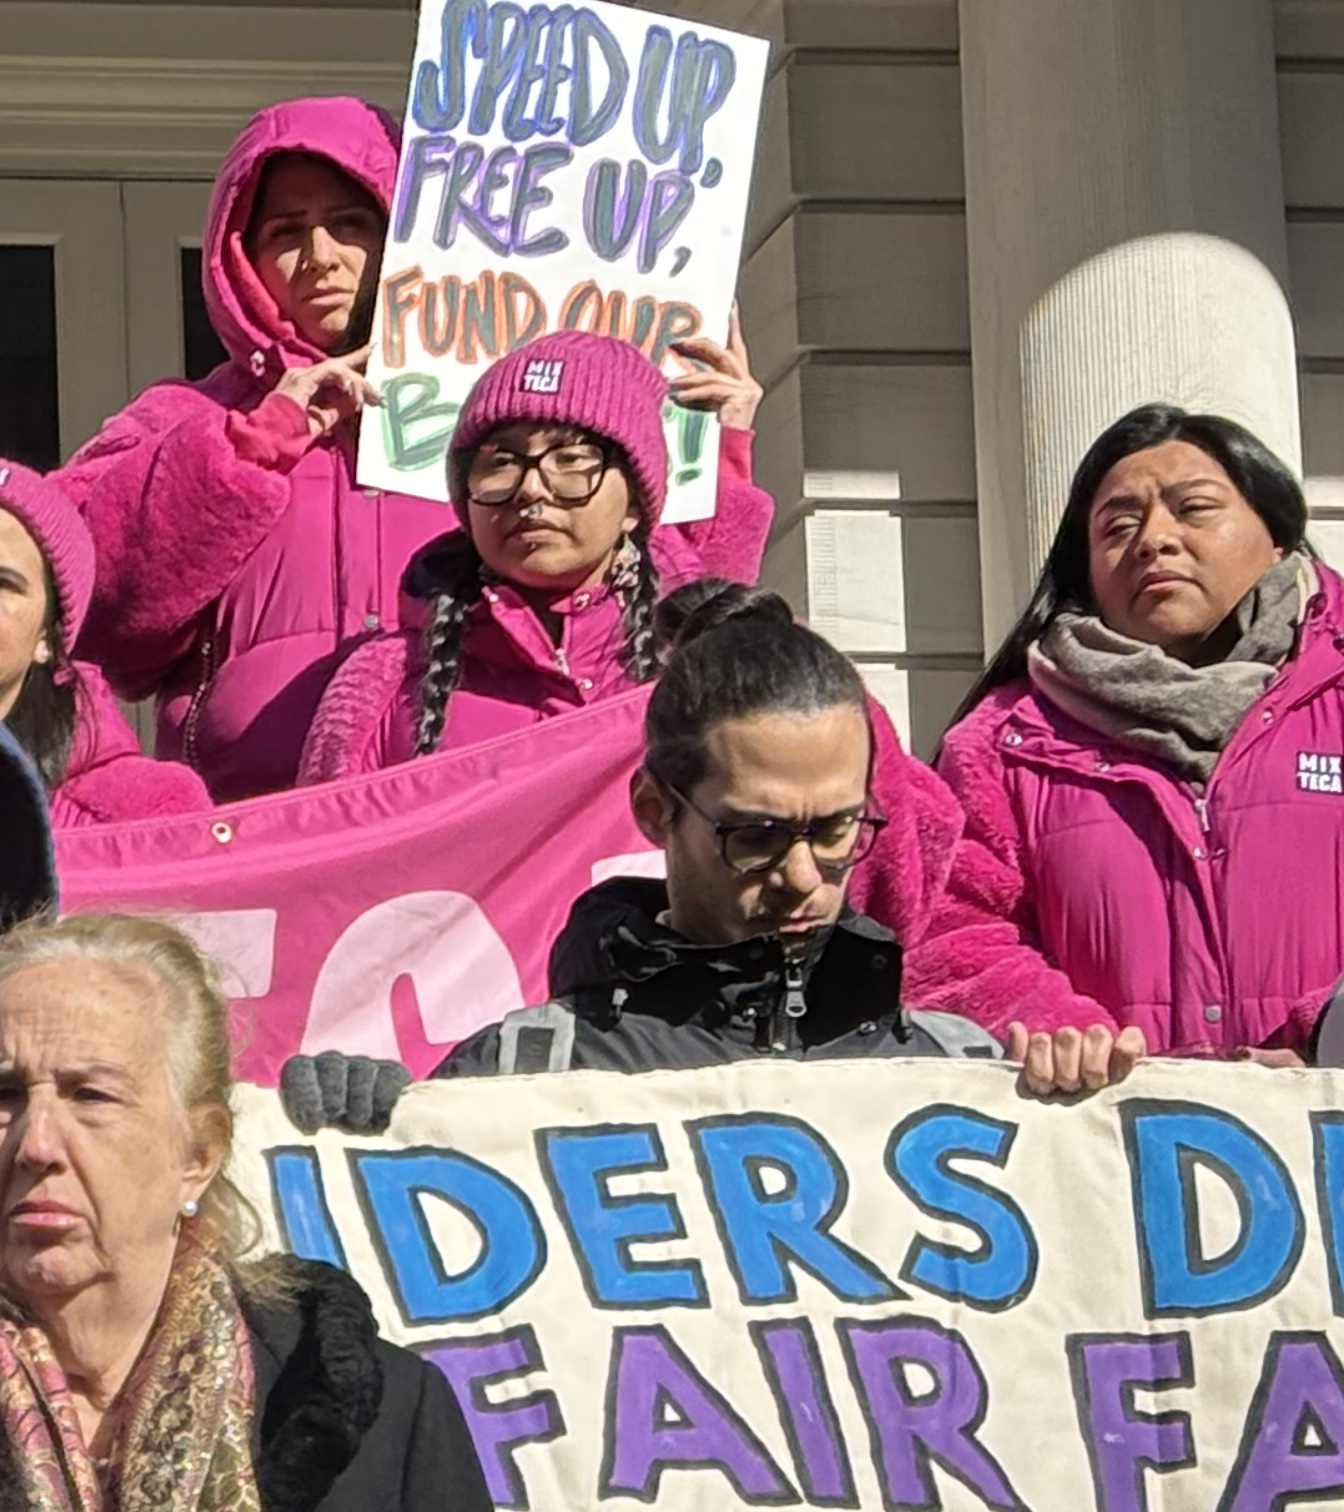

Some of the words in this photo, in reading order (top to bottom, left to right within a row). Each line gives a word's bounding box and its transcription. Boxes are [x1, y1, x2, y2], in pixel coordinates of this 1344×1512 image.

[411, 0, 630, 147] SPEED
[632, 24, 737, 189] UP,
[393, 134, 575, 258] FREE
[582, 157, 694, 278] UP,
[382, 265, 548, 370] FUND
[1296, 771, 1342, 793] TECA
[1298, 752, 1342, 774] MIX
[262, 1102, 1041, 1326] IDERS
